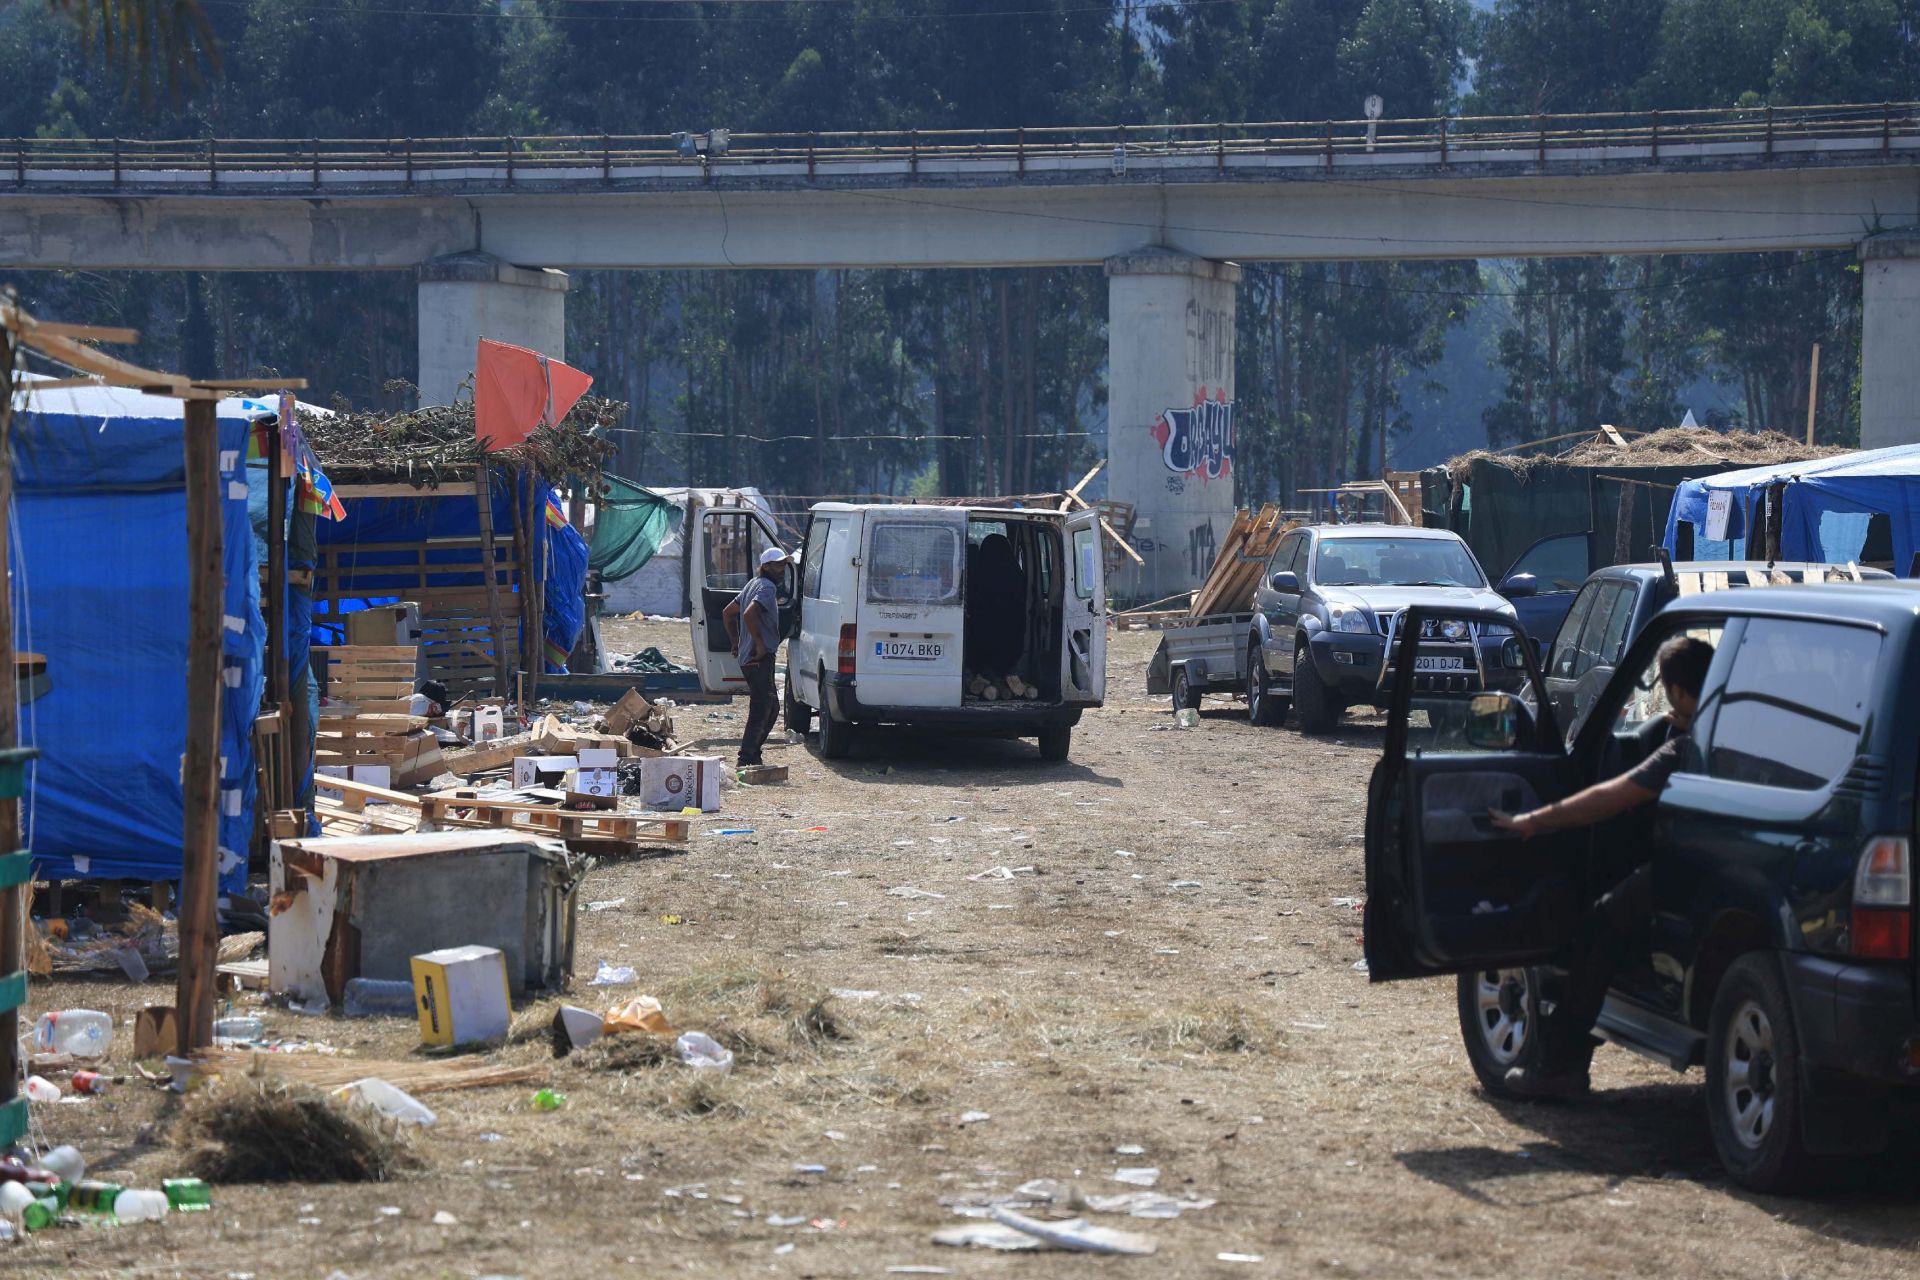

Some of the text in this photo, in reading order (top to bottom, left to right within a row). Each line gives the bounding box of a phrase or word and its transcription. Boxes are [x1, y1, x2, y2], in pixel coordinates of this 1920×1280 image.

[885, 643, 941, 656] 1074 BKB
[1416, 658, 1461, 669] 201 DJZ
